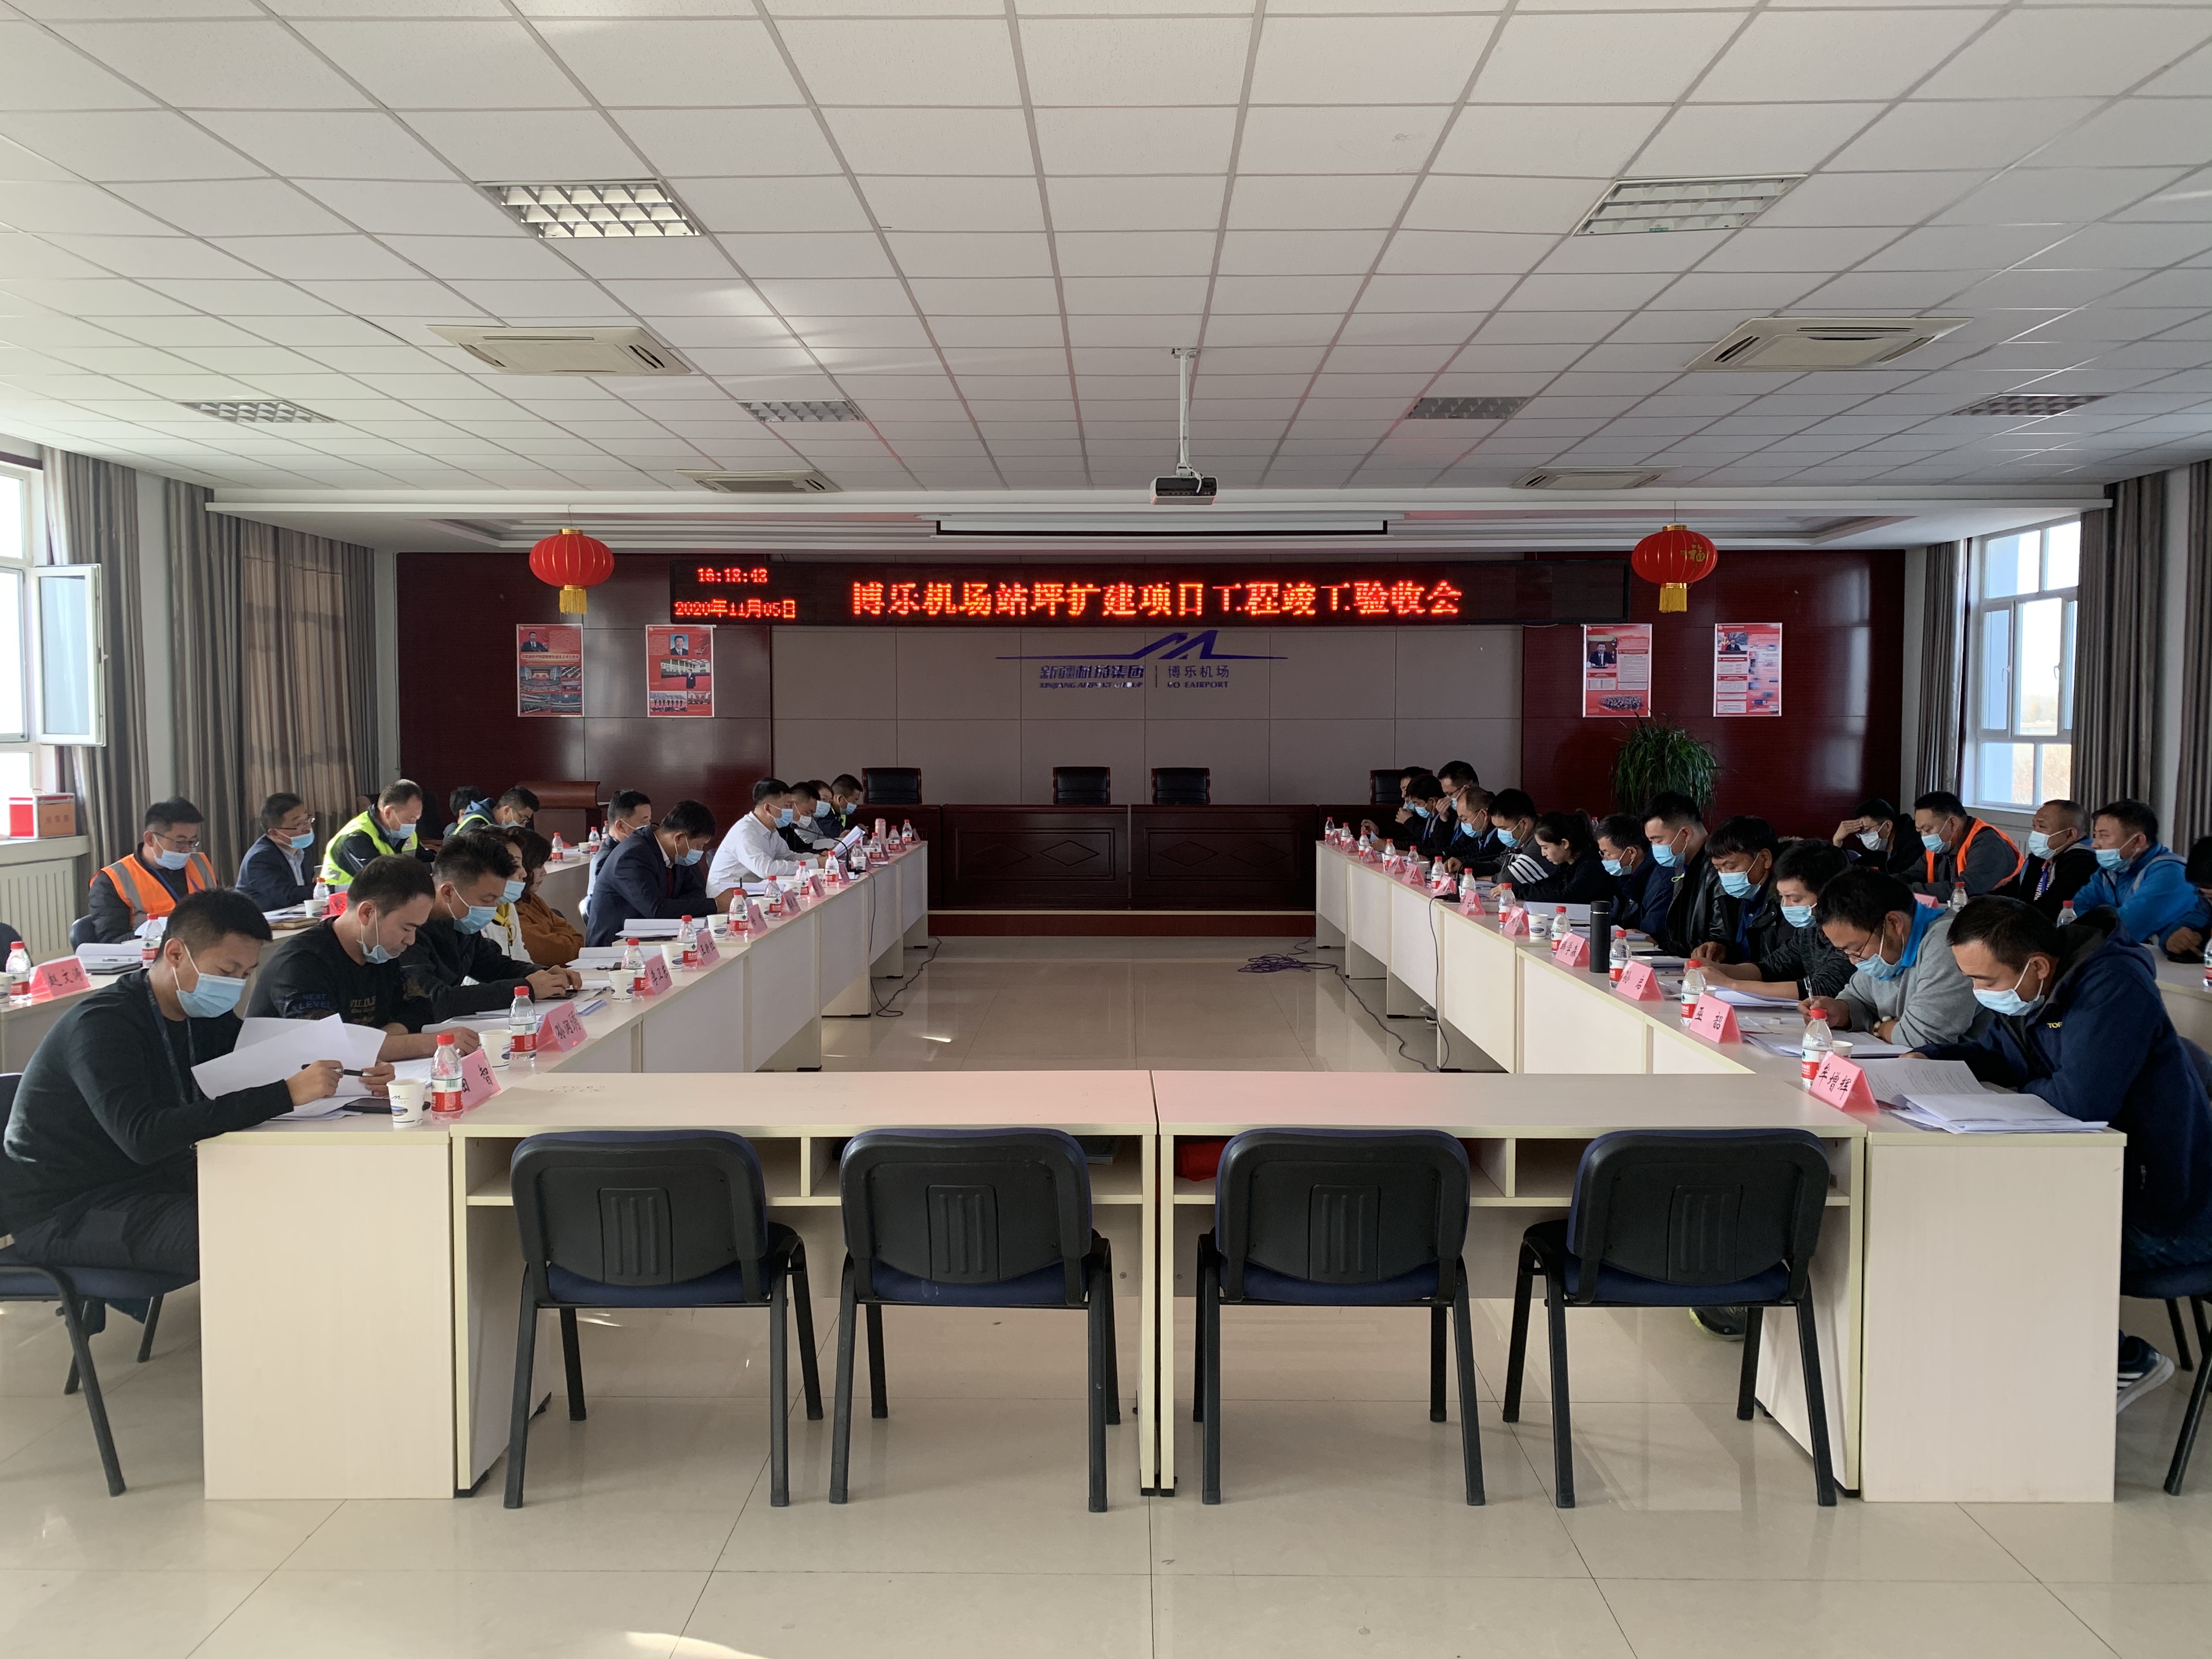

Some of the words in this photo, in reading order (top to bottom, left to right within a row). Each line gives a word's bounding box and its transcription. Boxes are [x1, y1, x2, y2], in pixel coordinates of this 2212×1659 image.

[1688, 544, 1706, 562] 福
[1168, 665, 1229, 678] 博乐机场
